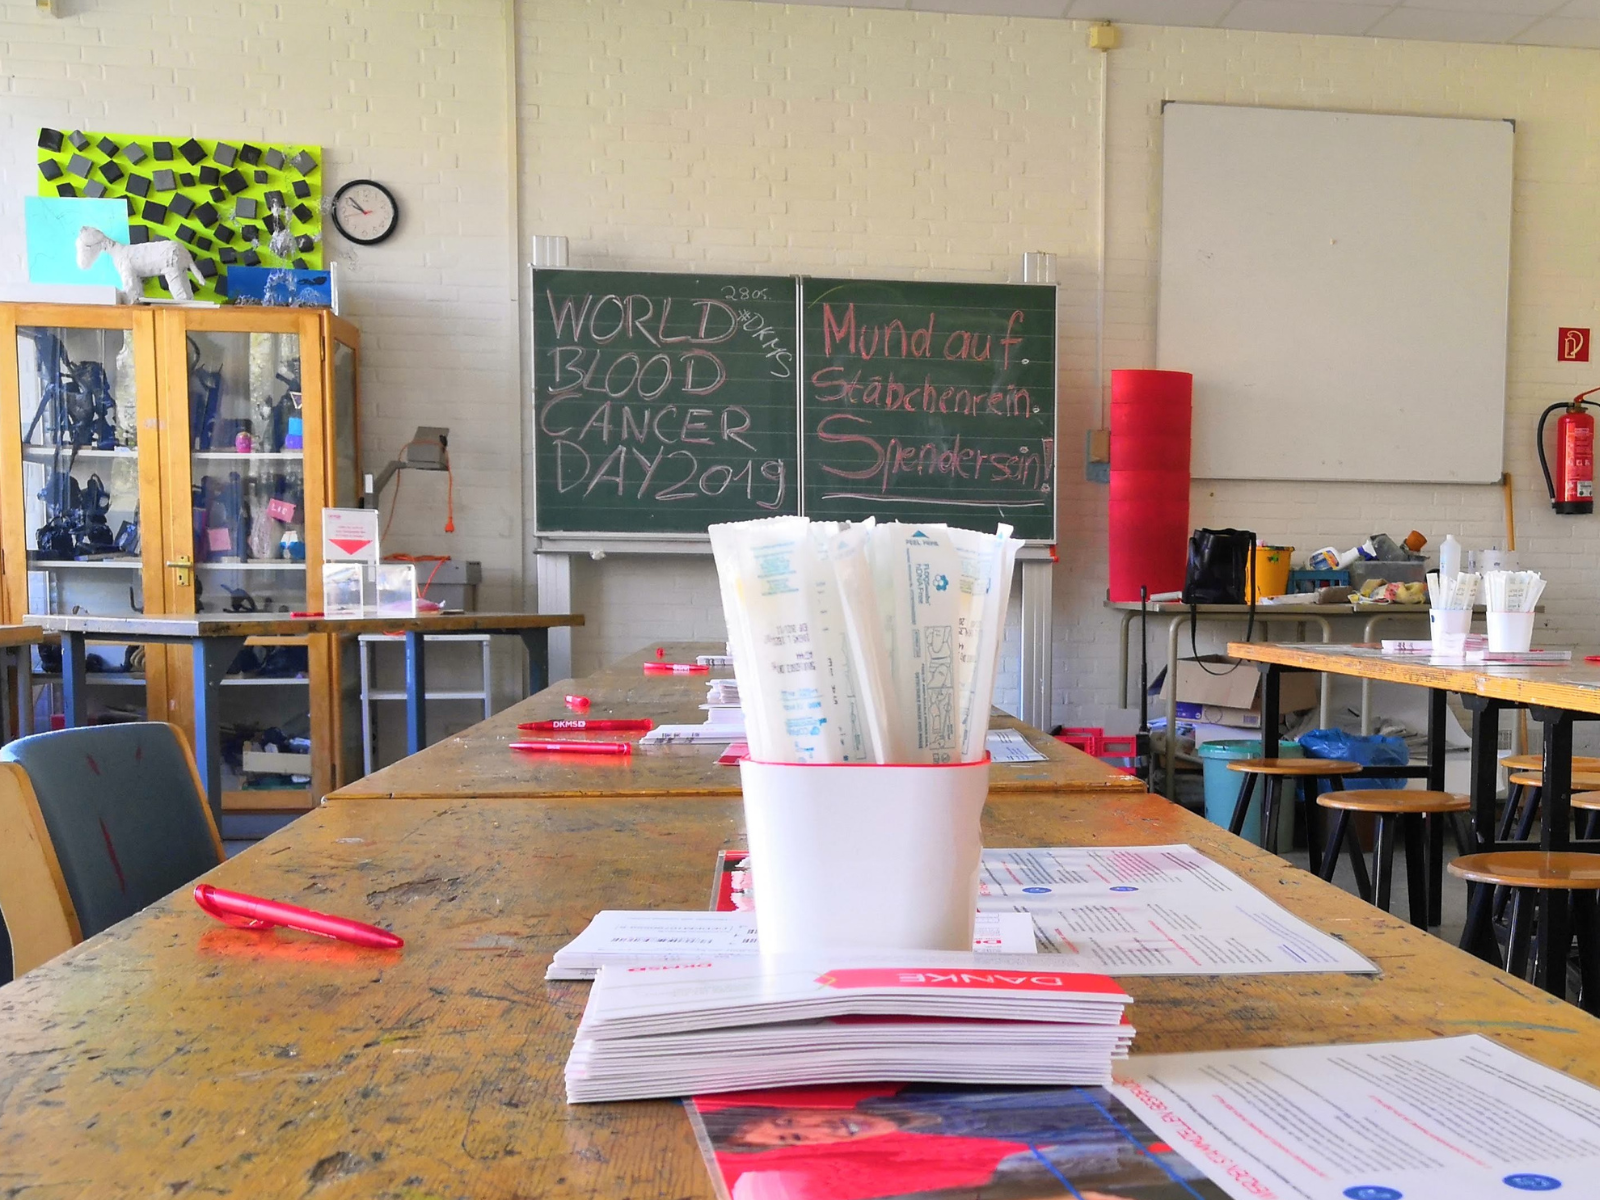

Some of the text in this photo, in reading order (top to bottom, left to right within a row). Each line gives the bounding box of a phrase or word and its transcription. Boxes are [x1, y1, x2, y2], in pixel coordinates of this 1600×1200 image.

[547, 288, 739, 347] WORLD
[823, 302, 934, 359] Mund
[547, 345, 726, 397] BLOOD
[540, 393, 757, 452] CANCER
[552, 720, 578, 728] DKMS
[897, 971, 1064, 986] DANKE
